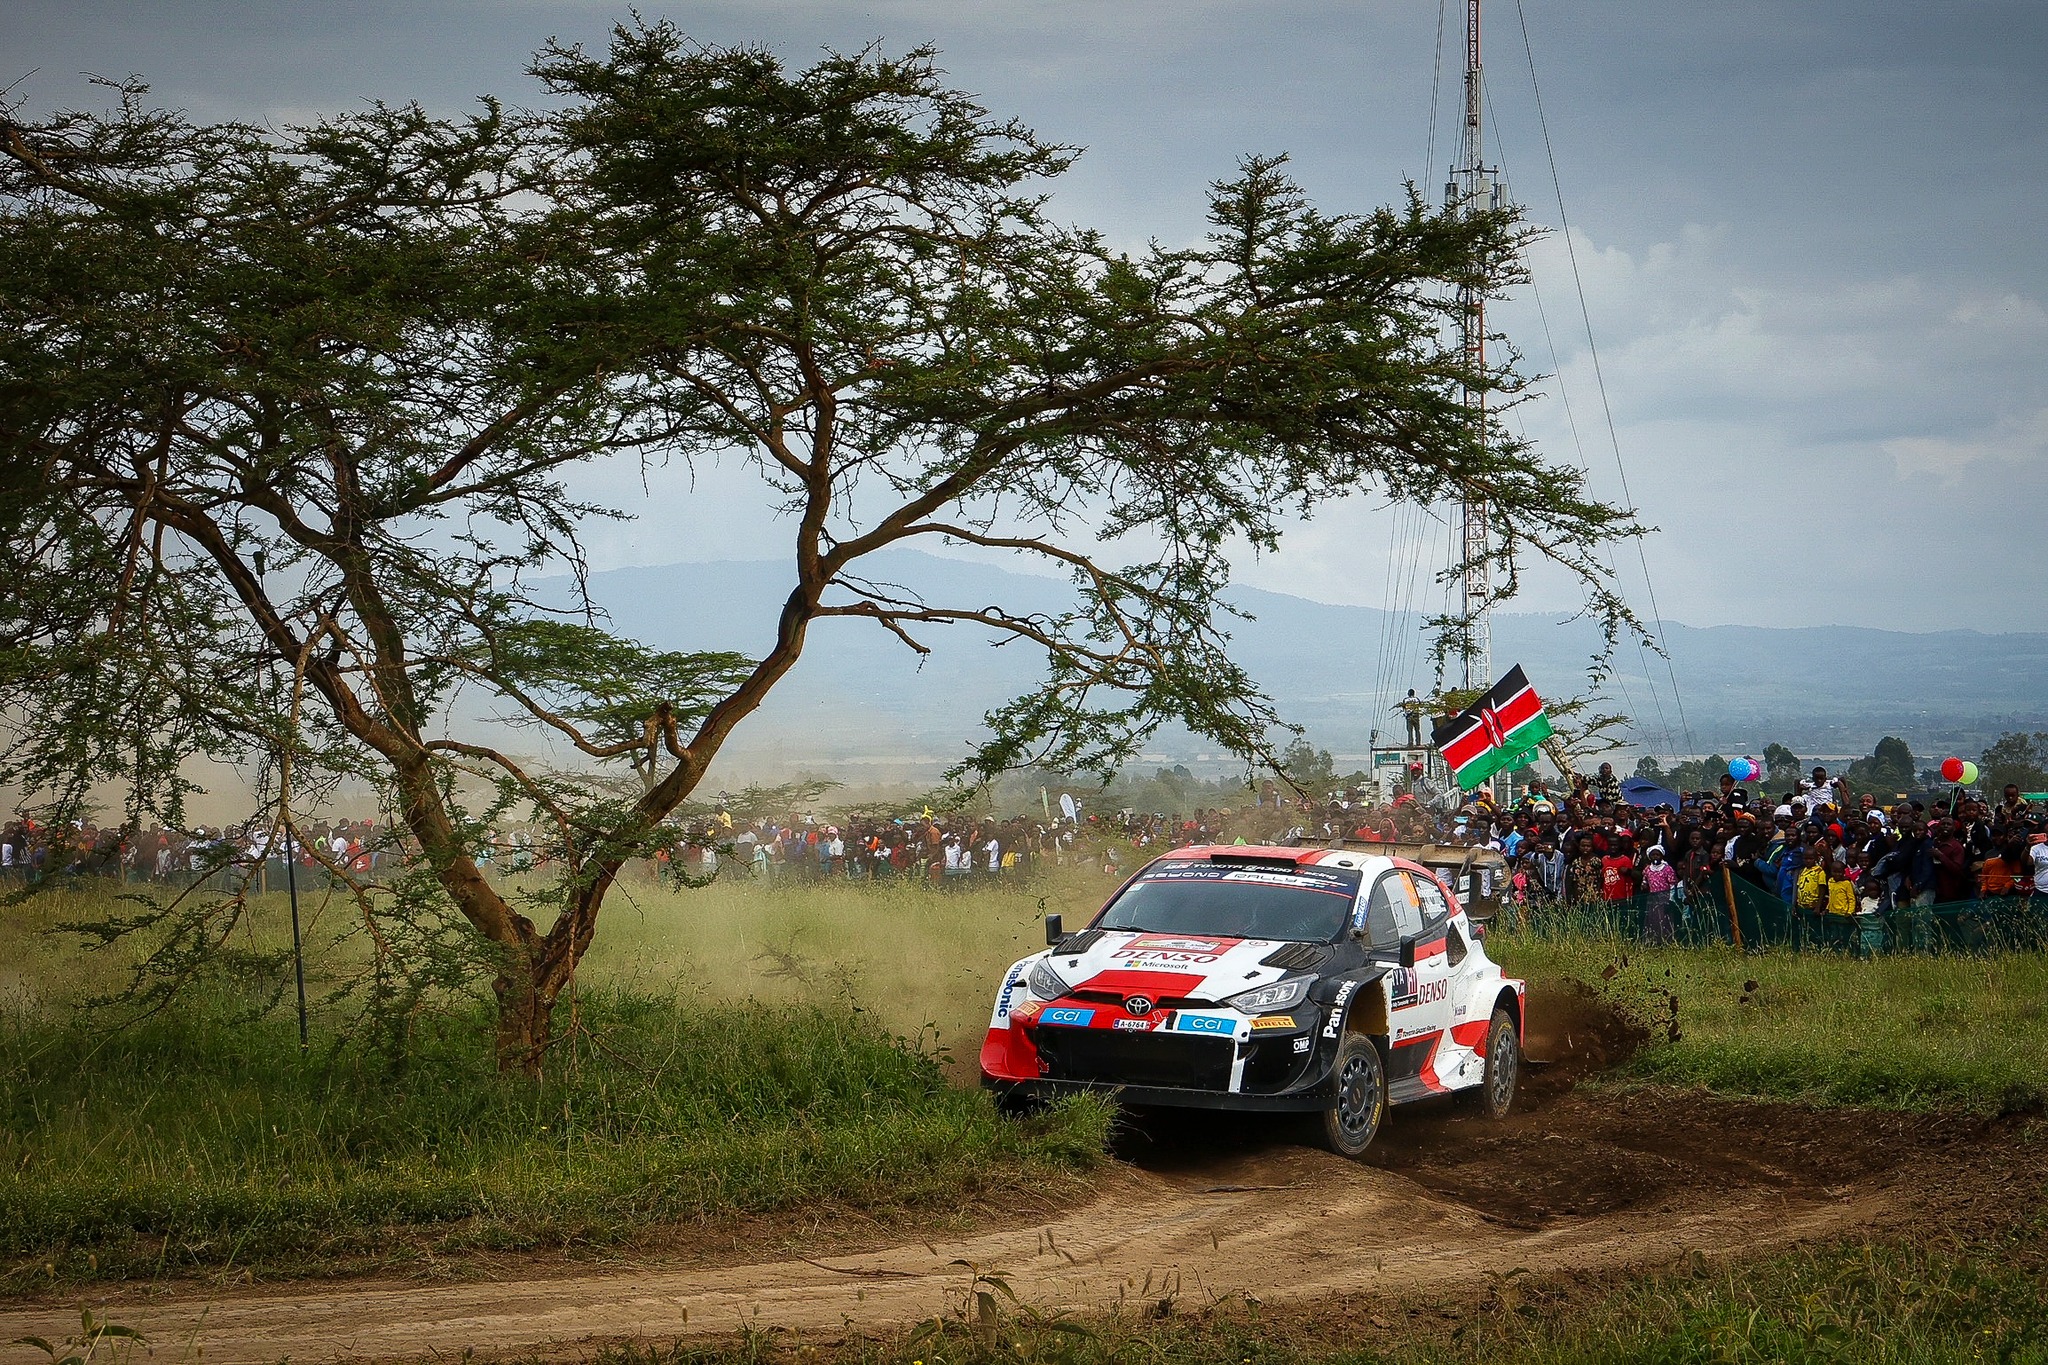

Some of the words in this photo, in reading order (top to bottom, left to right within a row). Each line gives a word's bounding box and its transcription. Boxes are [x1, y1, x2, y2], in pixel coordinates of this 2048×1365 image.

[1142, 871, 1221, 880] BEYOND
[1233, 872, 1299, 884] RALLY
[1243, 864, 1293, 873] GAZOO
[1293, 868, 1339, 881] Racing
[1110, 950, 1219, 964] DENSO
[1141, 960, 1189, 971] Microsoft
[997, 960, 1035, 1019] Panasonic
[1418, 978, 1448, 1006] DENSO
[1052, 1010, 1081, 1021] CCI
[1120, 1020, 1145, 1029] A-6764
[1192, 1018, 1223, 1031] CCI
[1252, 1018, 1293, 1029] PIRELLI
[1293, 1040, 1311, 1051] OMP
